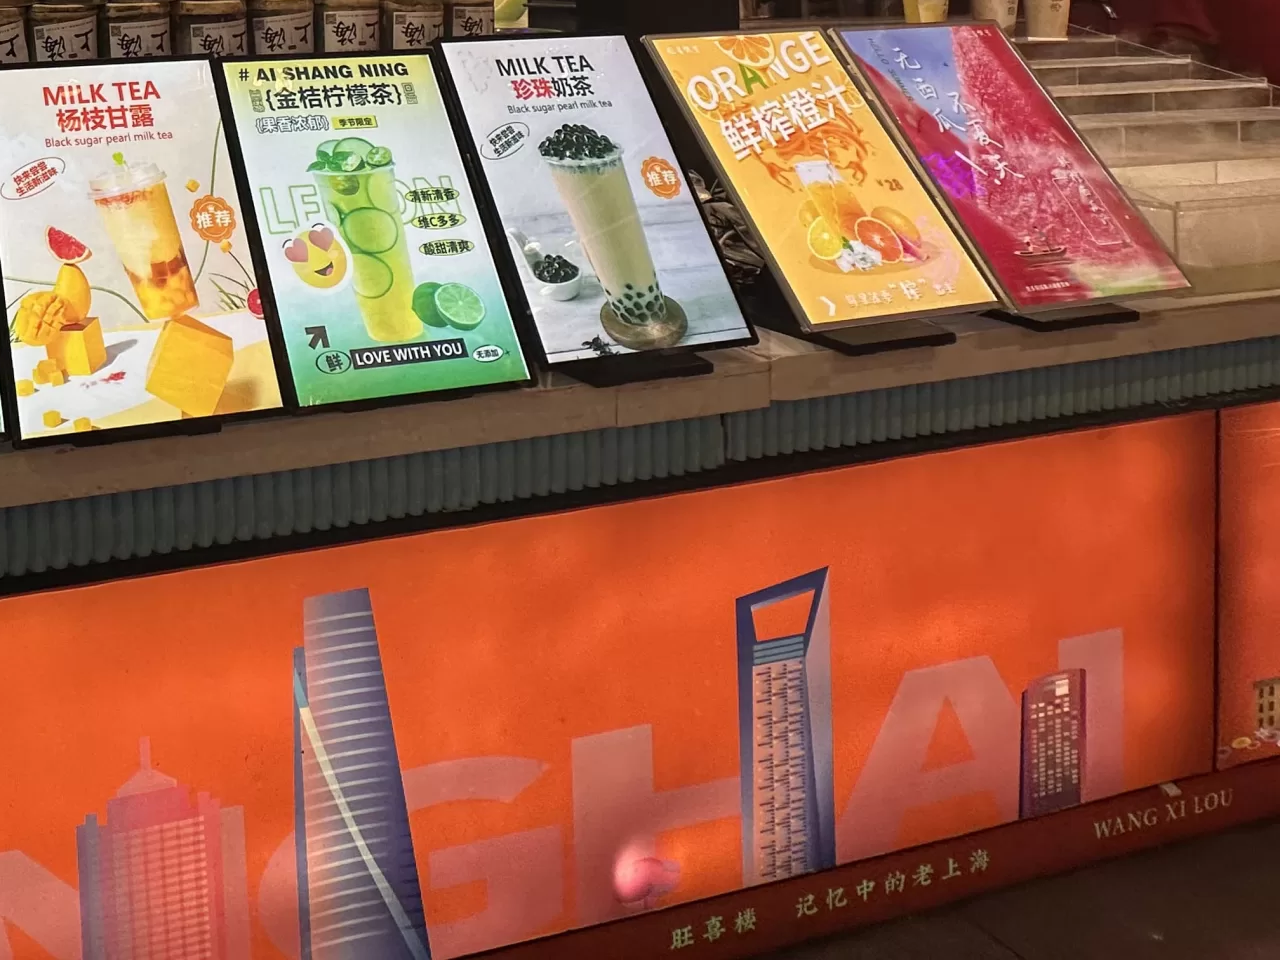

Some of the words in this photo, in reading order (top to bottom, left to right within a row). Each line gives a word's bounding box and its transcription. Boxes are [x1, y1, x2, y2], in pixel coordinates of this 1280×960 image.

[257, 66, 276, 82] AI
[283, 64, 354, 81] SHANG
[359, 62, 409, 78] NING
[495, 57, 547, 77] MILK
[551, 55, 594, 73] TEA
[42, 83, 104, 107] MILK
[112, 80, 161, 102] TEA
[511, 76, 595, 100] 珍珠奶茶
[507, 104, 530, 114] Black
[532, 103, 555, 114] sugar
[558, 101, 578, 113] pearl
[579, 100, 597, 109] milk
[598, 99, 613, 108] tea
[56, 104, 155, 133] 杨枝甘露
[338, 117, 373, 128] 季节限定
[719, 76, 853, 161] 鲜榨橙汁
[45, 137, 71, 149] Black
[74, 136, 103, 148] sugar
[106, 132, 131, 146] pearl
[134, 131, 156, 142] milk
[157, 130, 173, 141] tea
[13, 160, 47, 187] 快来尝尝
[646, 170, 677, 187] 推荐
[195, 210, 232, 230] 推荐
[417, 214, 460, 228] 维C多多
[423, 241, 470, 255] 酸甜清爽
[325, 354, 343, 371] 鲜
[356, 351, 391, 366] LOVE
[394, 347, 429, 363] WITH
[432, 343, 463, 358] YOU
[476, 348, 499, 359] 无添加
[1093, 806, 1158, 841] WANG
[1165, 799, 1188, 823] XI
[1193, 787, 1235, 816] LOU
[670, 907, 758, 951] 旺喜楼
[794, 848, 993, 920] 记忆中的老上海
